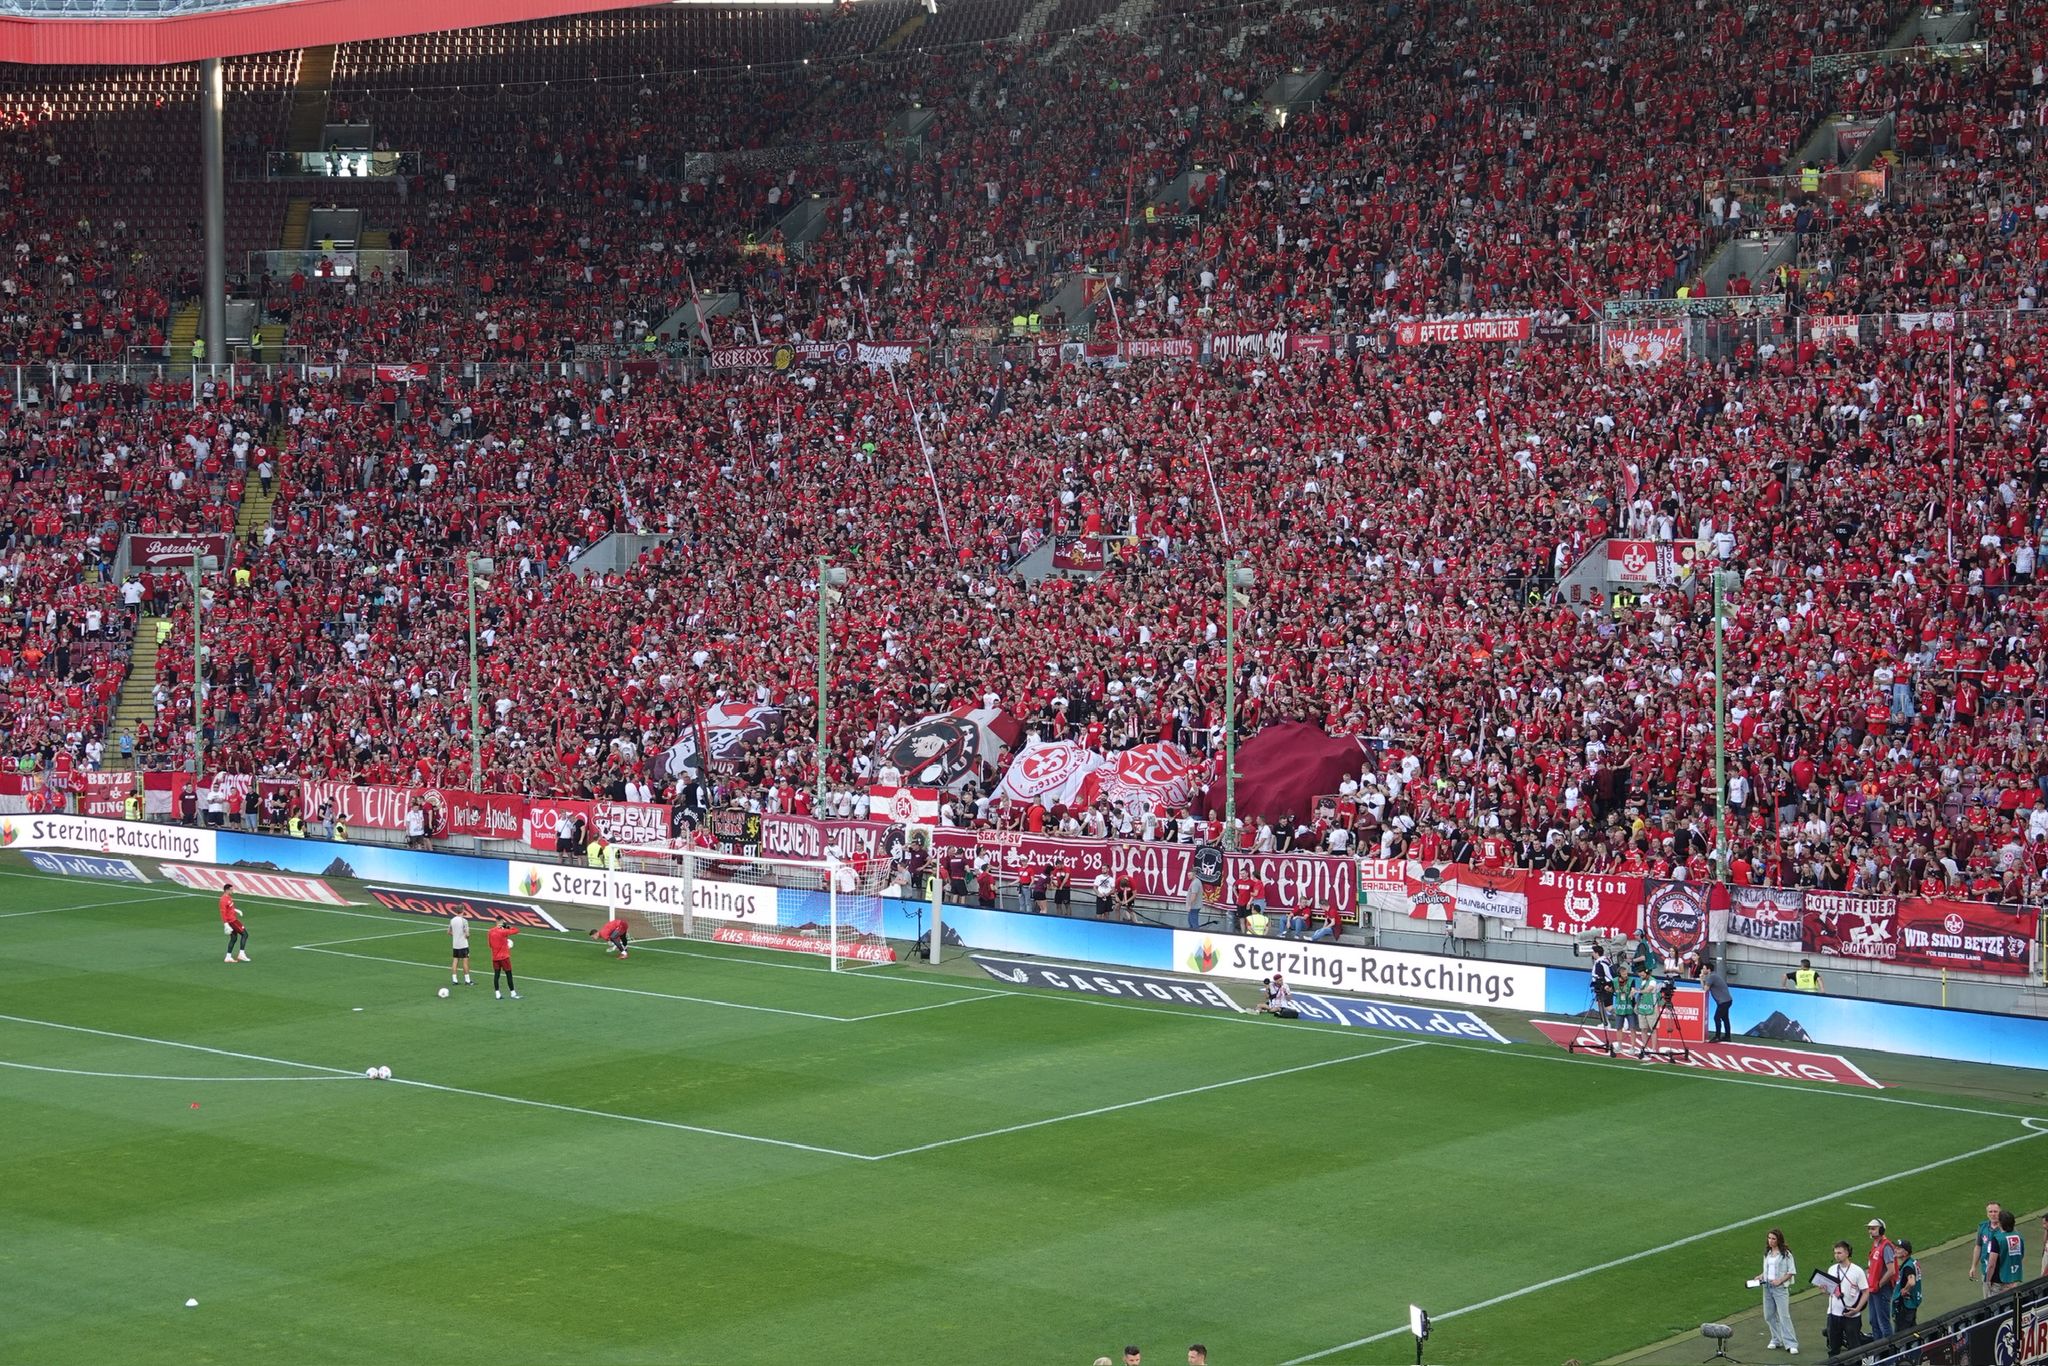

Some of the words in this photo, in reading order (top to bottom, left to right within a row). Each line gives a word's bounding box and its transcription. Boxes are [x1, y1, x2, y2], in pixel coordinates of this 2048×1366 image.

[1420, 324, 1459, 342] BETZE
[1463, 320, 1519, 340] SUPPORTERS
[711, 350, 769, 367] KERBEROS
[1163, 340, 1193, 355] BOYS
[87, 772, 132, 785] BETZE
[762, 818, 820, 857] FRENETIC
[978, 831, 996, 841] SEK
[1008, 833, 1020, 844] SV
[66, 858, 136, 880] vlh.de
[1110, 845, 1191, 897] PFALZ
[1362, 882, 1404, 892] ERHALTEN
[1539, 871, 1627, 895] Division
[1904, 928, 1929, 948] WIR
[1931, 933, 1962, 949] SIND
[1964, 936, 2005, 957] BETZE
[1233, 943, 1515, 1002] Sterzing-Ratschings
[1041, 970, 1227, 1008] CASTORE
[1349, 1006, 1486, 1037] vlh.de
